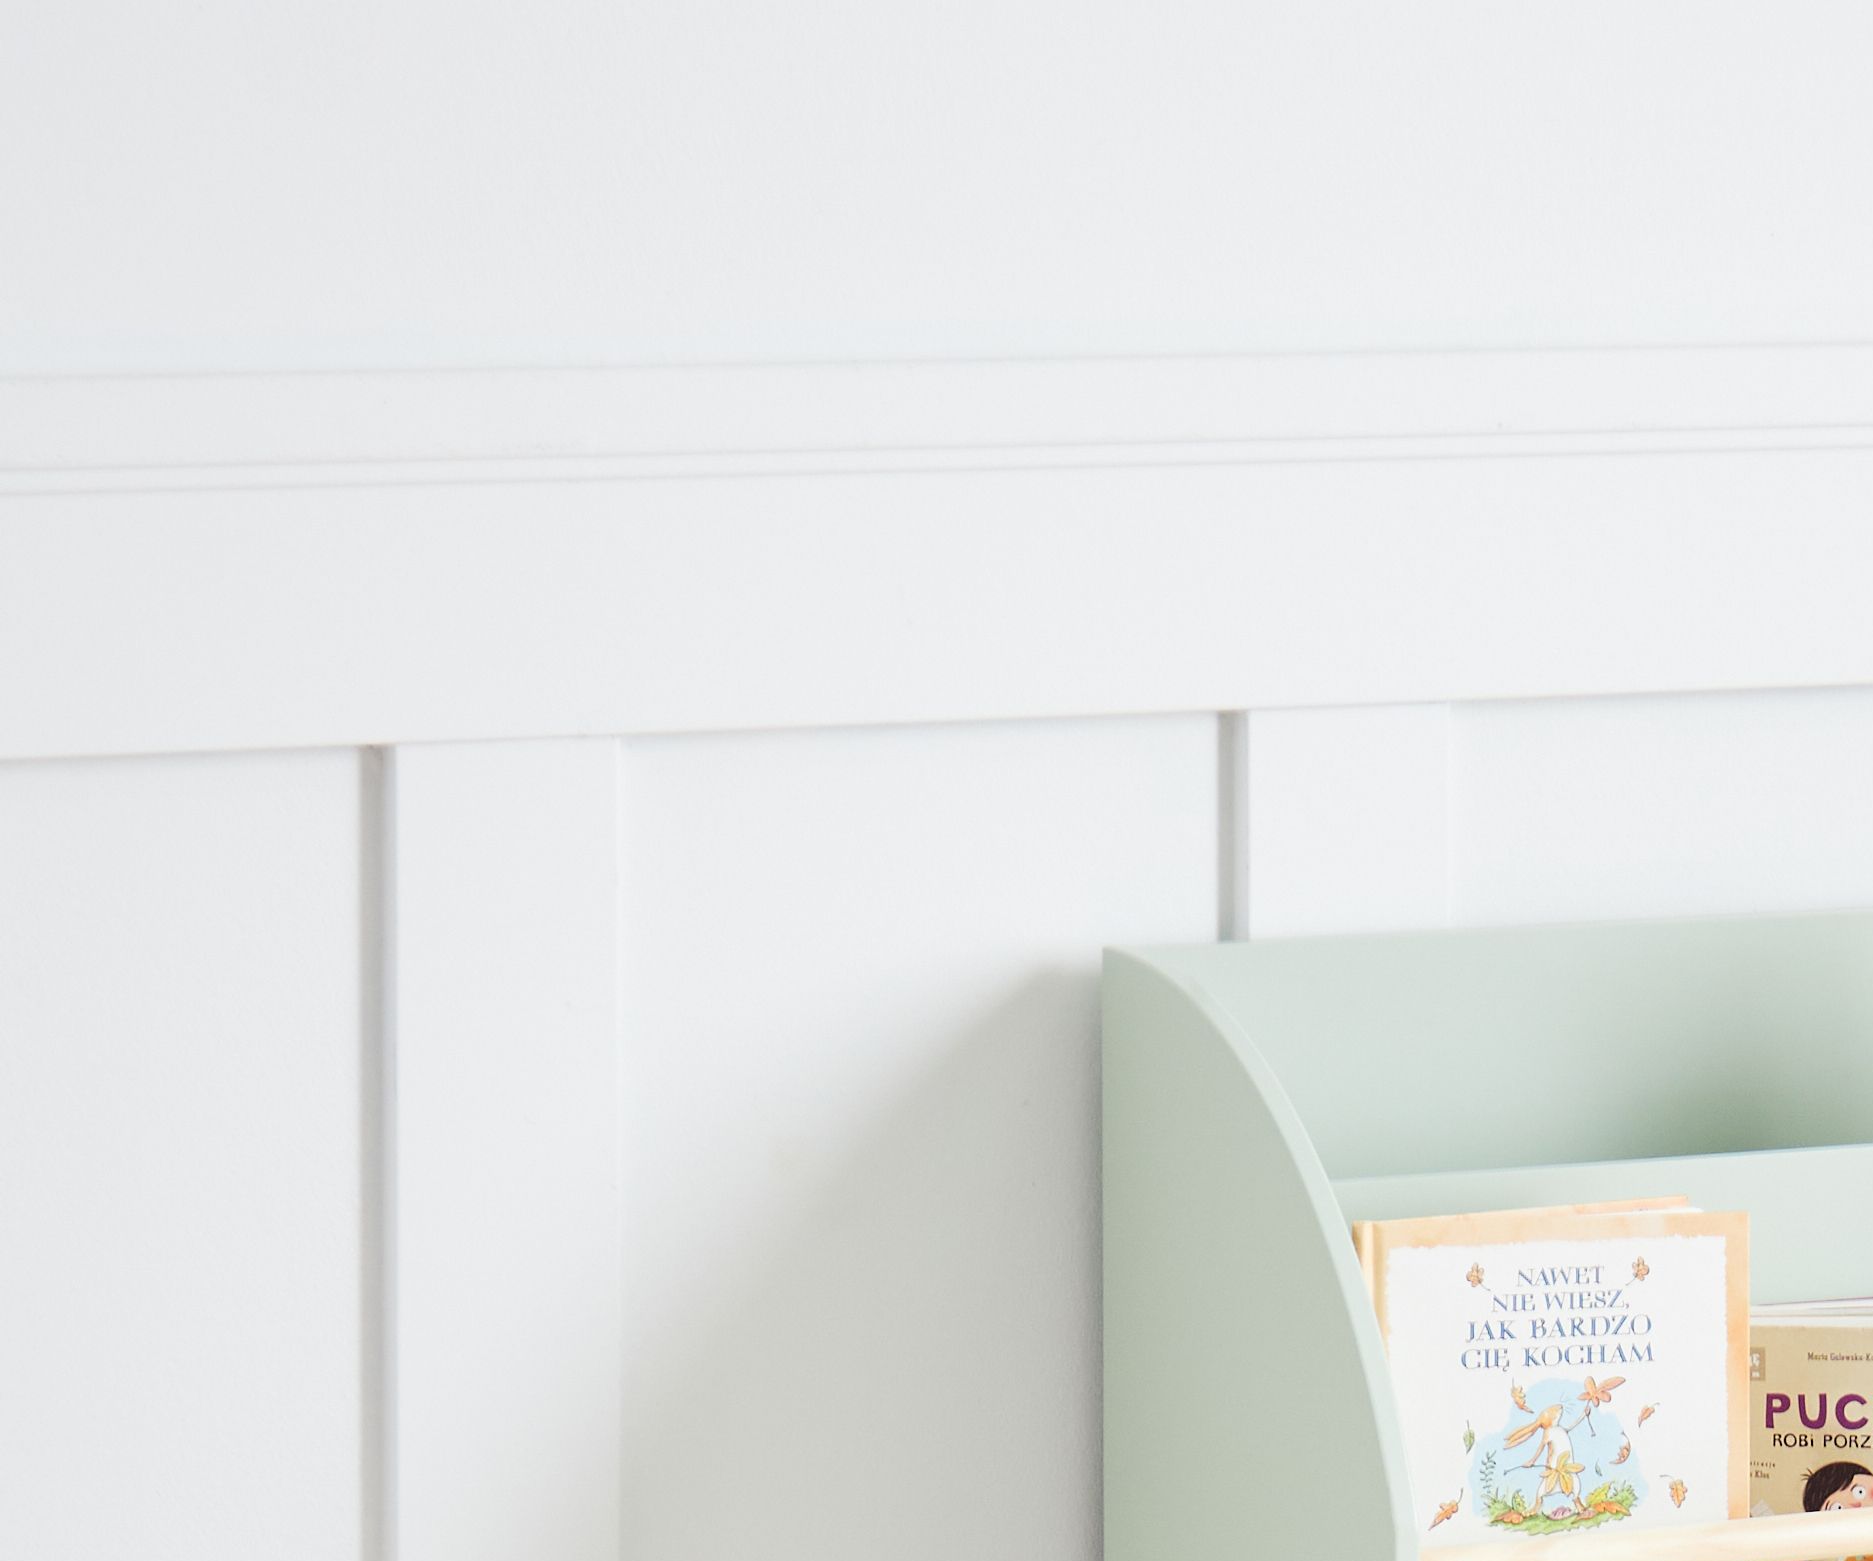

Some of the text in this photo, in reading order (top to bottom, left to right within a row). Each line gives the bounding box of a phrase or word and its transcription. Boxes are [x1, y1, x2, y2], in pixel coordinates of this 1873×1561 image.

[1517, 1265, 1605, 1287] NAWET
[1491, 1288, 1630, 1313] NIE WIESZ,
[1465, 1313, 1653, 1343] JAK BARDZO
[1460, 1342, 1655, 1372] CIĘ KOCHAM
